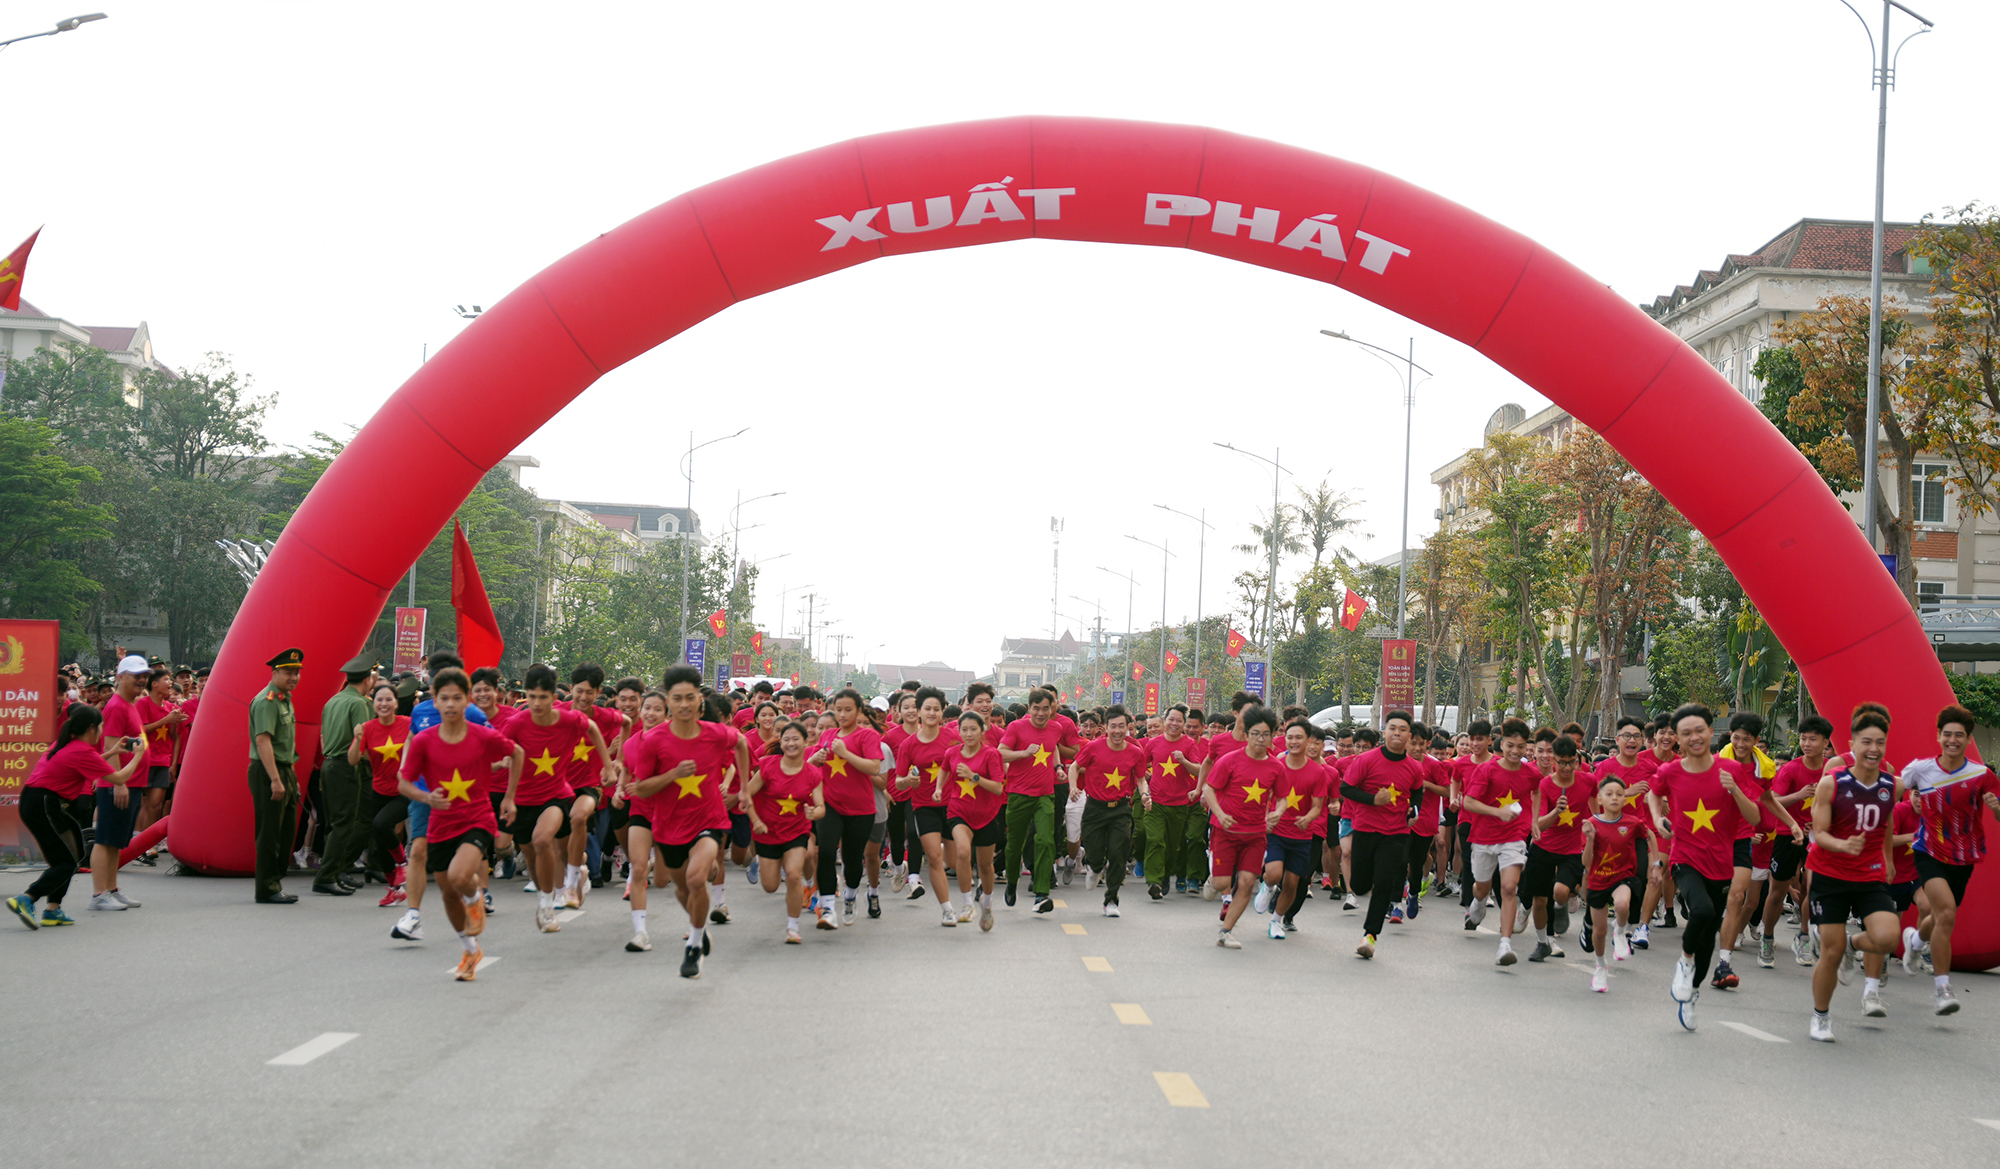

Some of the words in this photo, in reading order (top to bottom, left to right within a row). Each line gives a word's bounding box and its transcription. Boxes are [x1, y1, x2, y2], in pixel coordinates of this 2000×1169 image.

[814, 175, 1076, 252] XUẤT
[1144, 193, 1411, 275] PHÁT
[5, 688, 39, 701] DÂN
[7, 721, 34, 735] THỂ
[1855, 803, 1880, 832] 10
